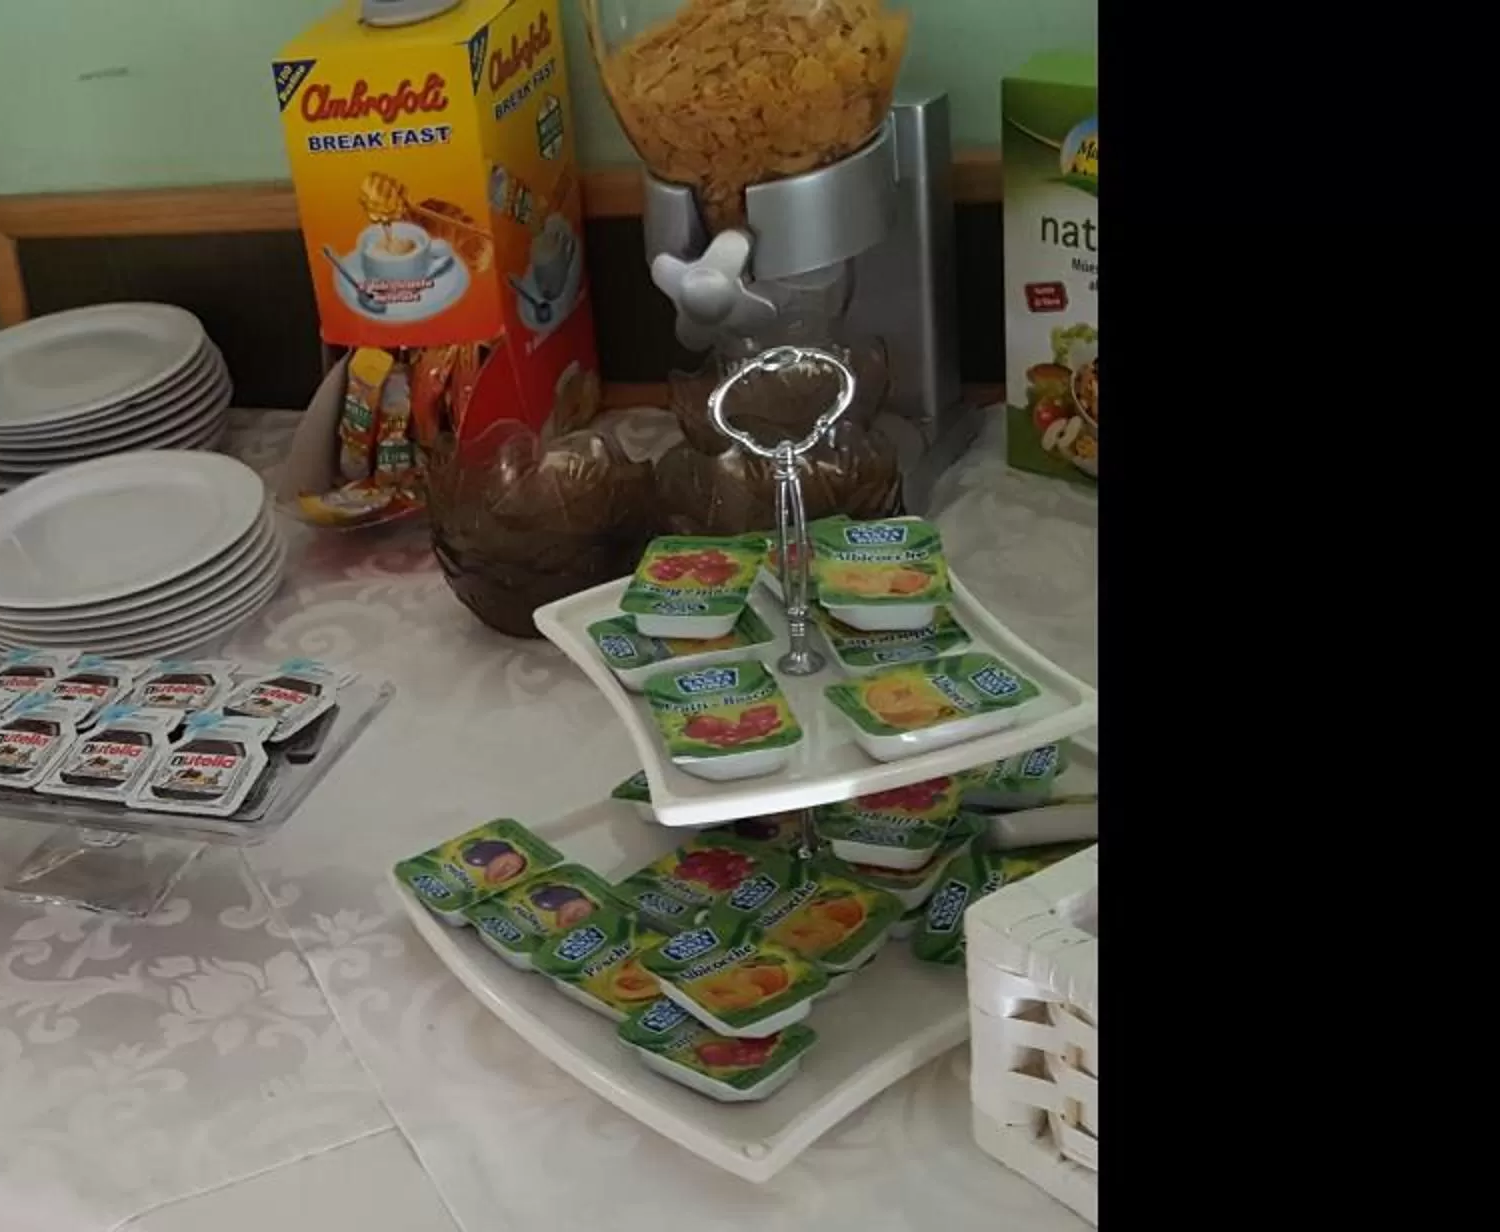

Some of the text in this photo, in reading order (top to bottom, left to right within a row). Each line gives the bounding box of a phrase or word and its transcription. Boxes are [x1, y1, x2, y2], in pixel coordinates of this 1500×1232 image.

[308, 126, 452, 152] BREAK FAST
[144, 683, 206, 697] nutella
[82, 742, 144, 758] nutella
[170, 754, 237, 769] nutella
